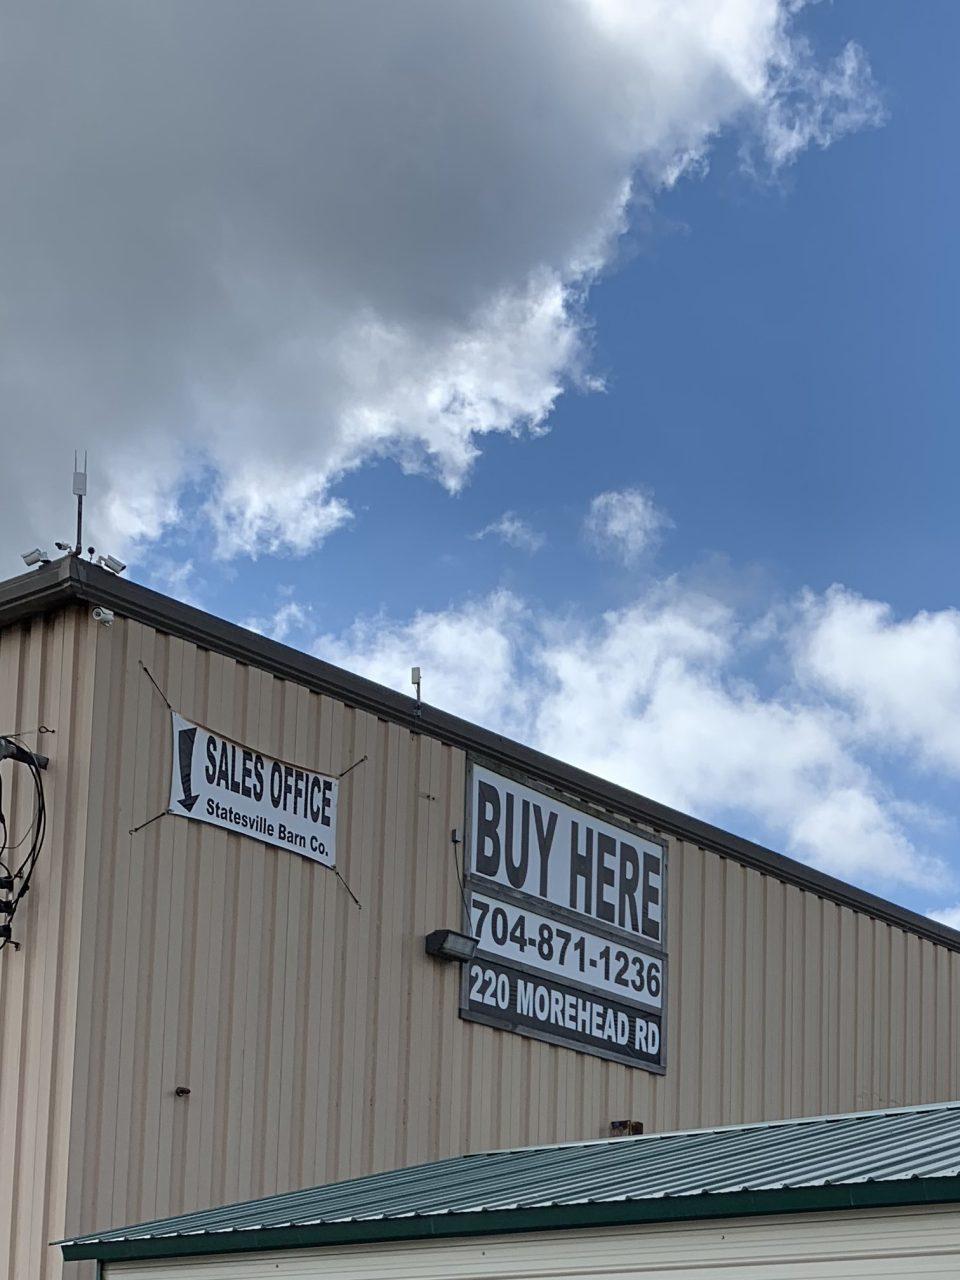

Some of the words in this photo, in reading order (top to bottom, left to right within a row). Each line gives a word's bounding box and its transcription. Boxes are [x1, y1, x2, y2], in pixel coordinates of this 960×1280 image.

[205, 735, 264, 802] SALES
[270, 761, 332, 827] OFFICE
[206, 798, 274, 837] Statesville
[278, 824, 306, 848] Barn
[310, 836, 329, 856] Co.
[476, 780, 559, 898] BUY
[569, 820, 660, 941] HERE
[472, 899, 661, 997] 704-871-1236
[470, 965, 510, 1010] 220
[516, 979, 629, 1045] MOREHEAD
[635, 1017, 660, 1055] RD
